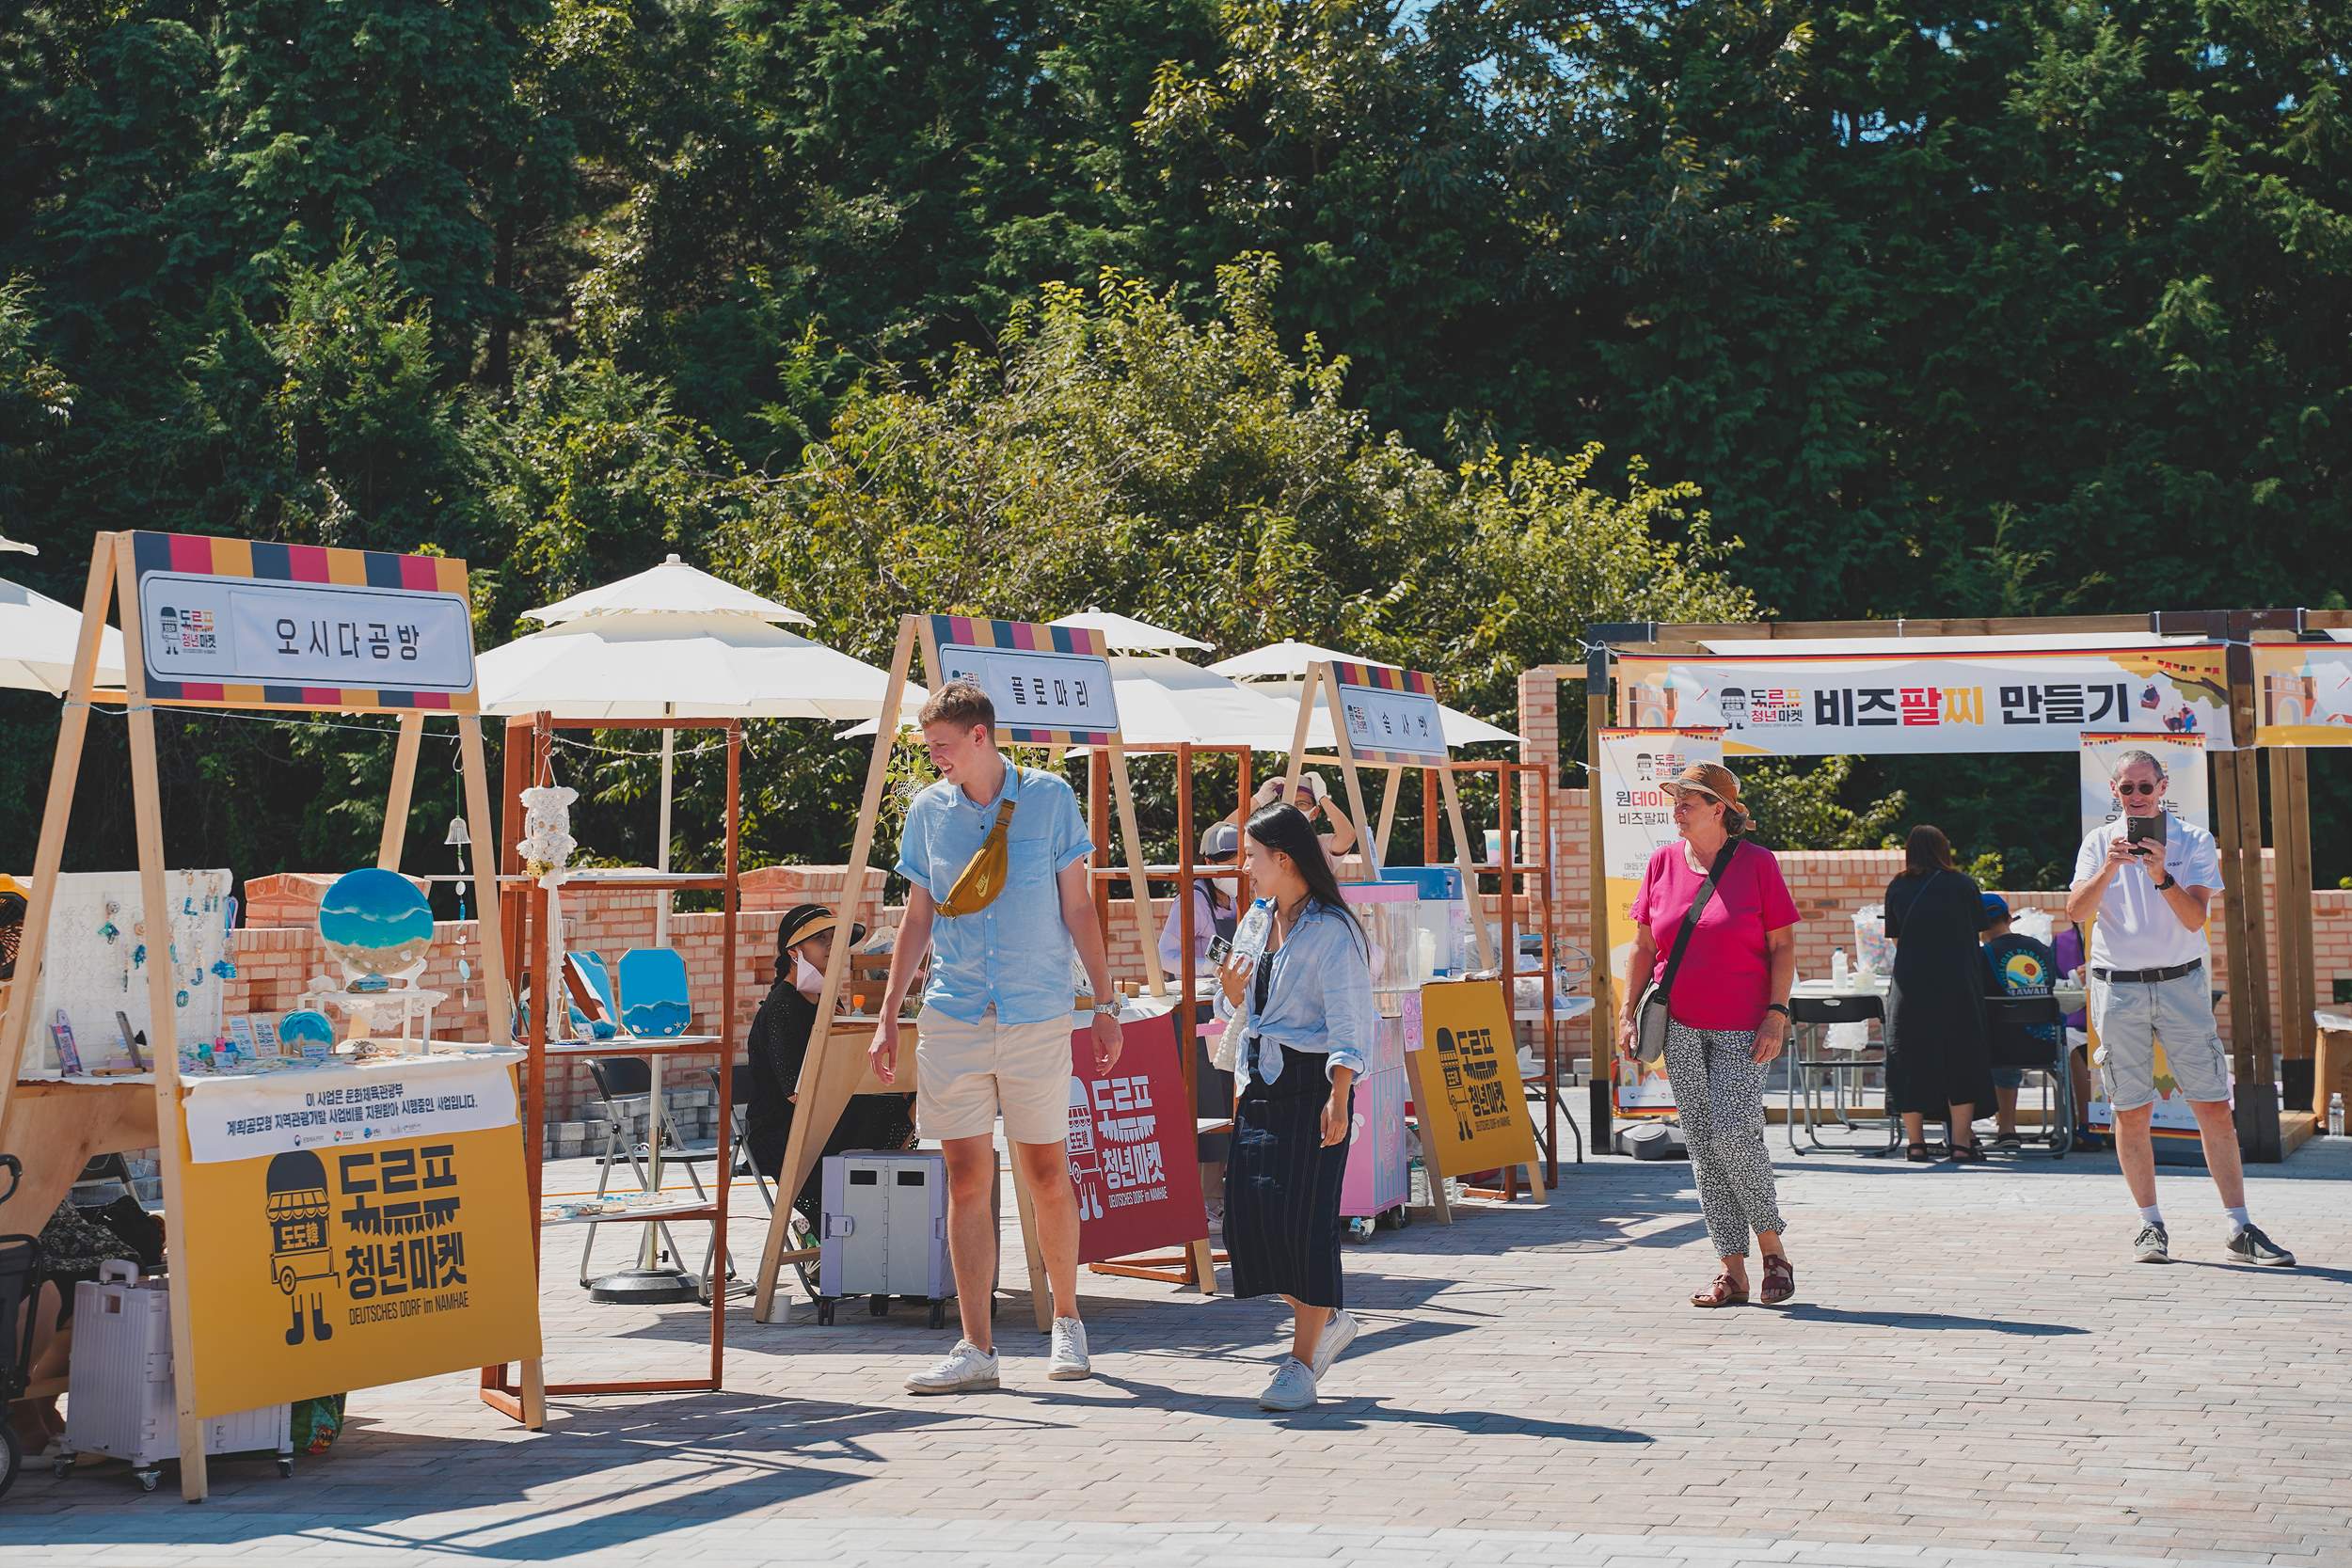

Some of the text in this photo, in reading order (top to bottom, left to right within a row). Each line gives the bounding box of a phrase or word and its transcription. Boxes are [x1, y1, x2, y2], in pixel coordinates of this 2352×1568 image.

[277, 618, 420, 661] 오시다공방
[1011, 676, 1089, 707] 플로마리
[1814, 683, 2130, 727] 비즈팔찌 만들기
[1751, 709, 1803, 722] 청년마켓
[1618, 812, 1669, 825] 비즈팔찌
[975, 873, 987, 894] NIKE
[306, 1093, 315, 1107] 이
[318, 1089, 343, 1106] 사업은
[227, 1115, 272, 1136] 계획공모형
[275, 1109, 327, 1129] 지역관광개발
[329, 1106, 363, 1123] 사업비를
[365, 1101, 399, 1119] 지원받아
[402, 1097, 435, 1115] 시행중인
[1102, 1141, 1166, 1190] 청년마켓
[345, 1231, 468, 1300] 청년마켓
[349, 1291, 469, 1325] DEUTSCHES DORF im NAMHAE
